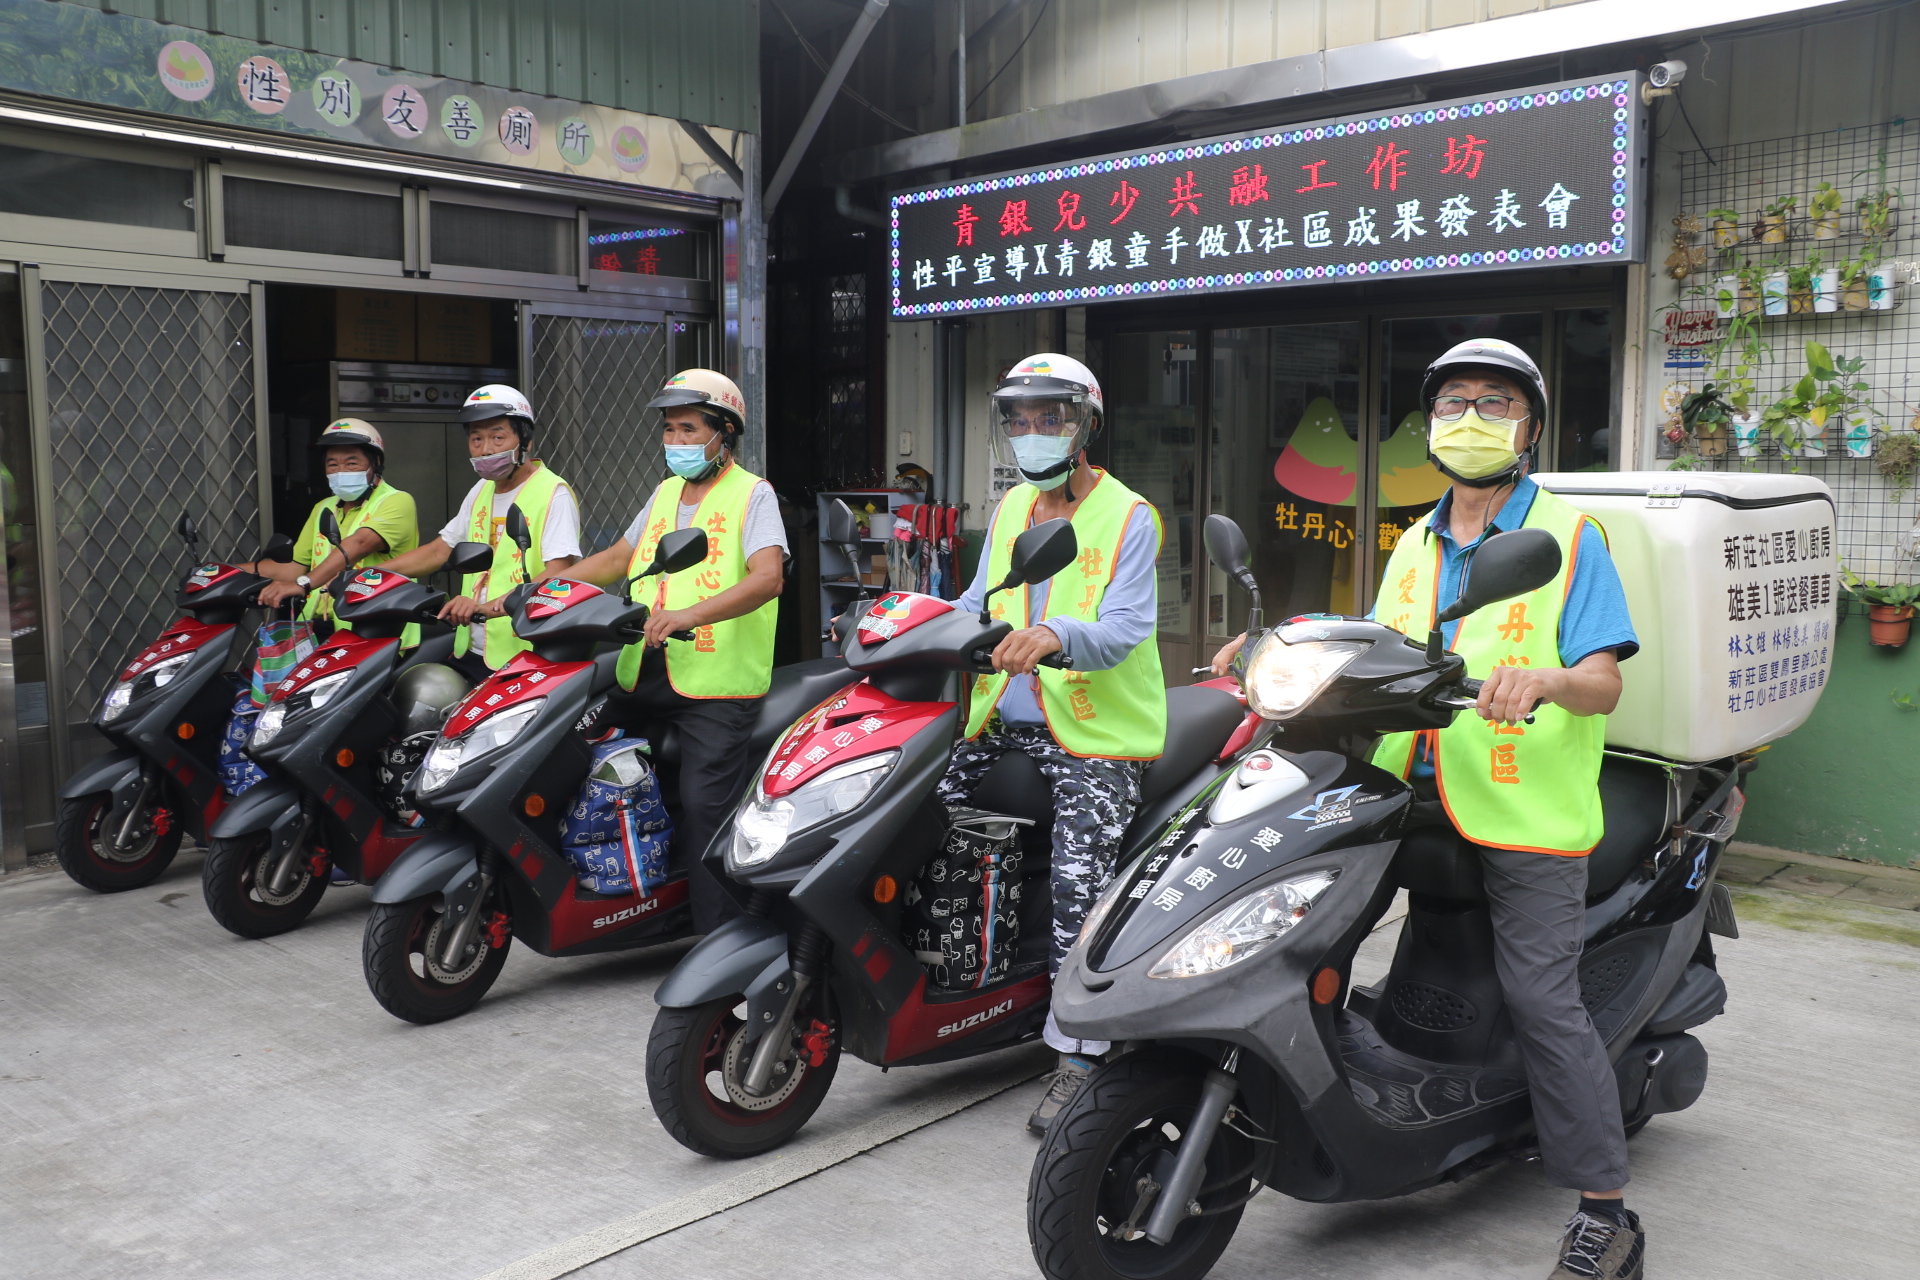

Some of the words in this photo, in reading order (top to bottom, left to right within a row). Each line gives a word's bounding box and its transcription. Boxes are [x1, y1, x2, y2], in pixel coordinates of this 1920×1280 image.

[243, 61, 590, 158] 性別友善廁所
[952, 134, 1488, 246] 青銀兒少共融工作坊
[912, 183, 1580, 291] 性平宣導X青銀童手做X社區成果發表會
[1664, 325, 1729, 345] Christma
[1275, 503, 1355, 549] 牡丹心
[1724, 526, 1830, 571] 新莊社區愛心廚房
[694, 511, 728, 652] 牡丹心區
[1727, 572, 1831, 622] 雄美1號送餐專車
[780, 716, 884, 780] 愛心廚房
[1152, 826, 1284, 912] 愛心廚房
[592, 898, 658, 928] SUZUKI
[936, 999, 1013, 1038] SUZUKI
